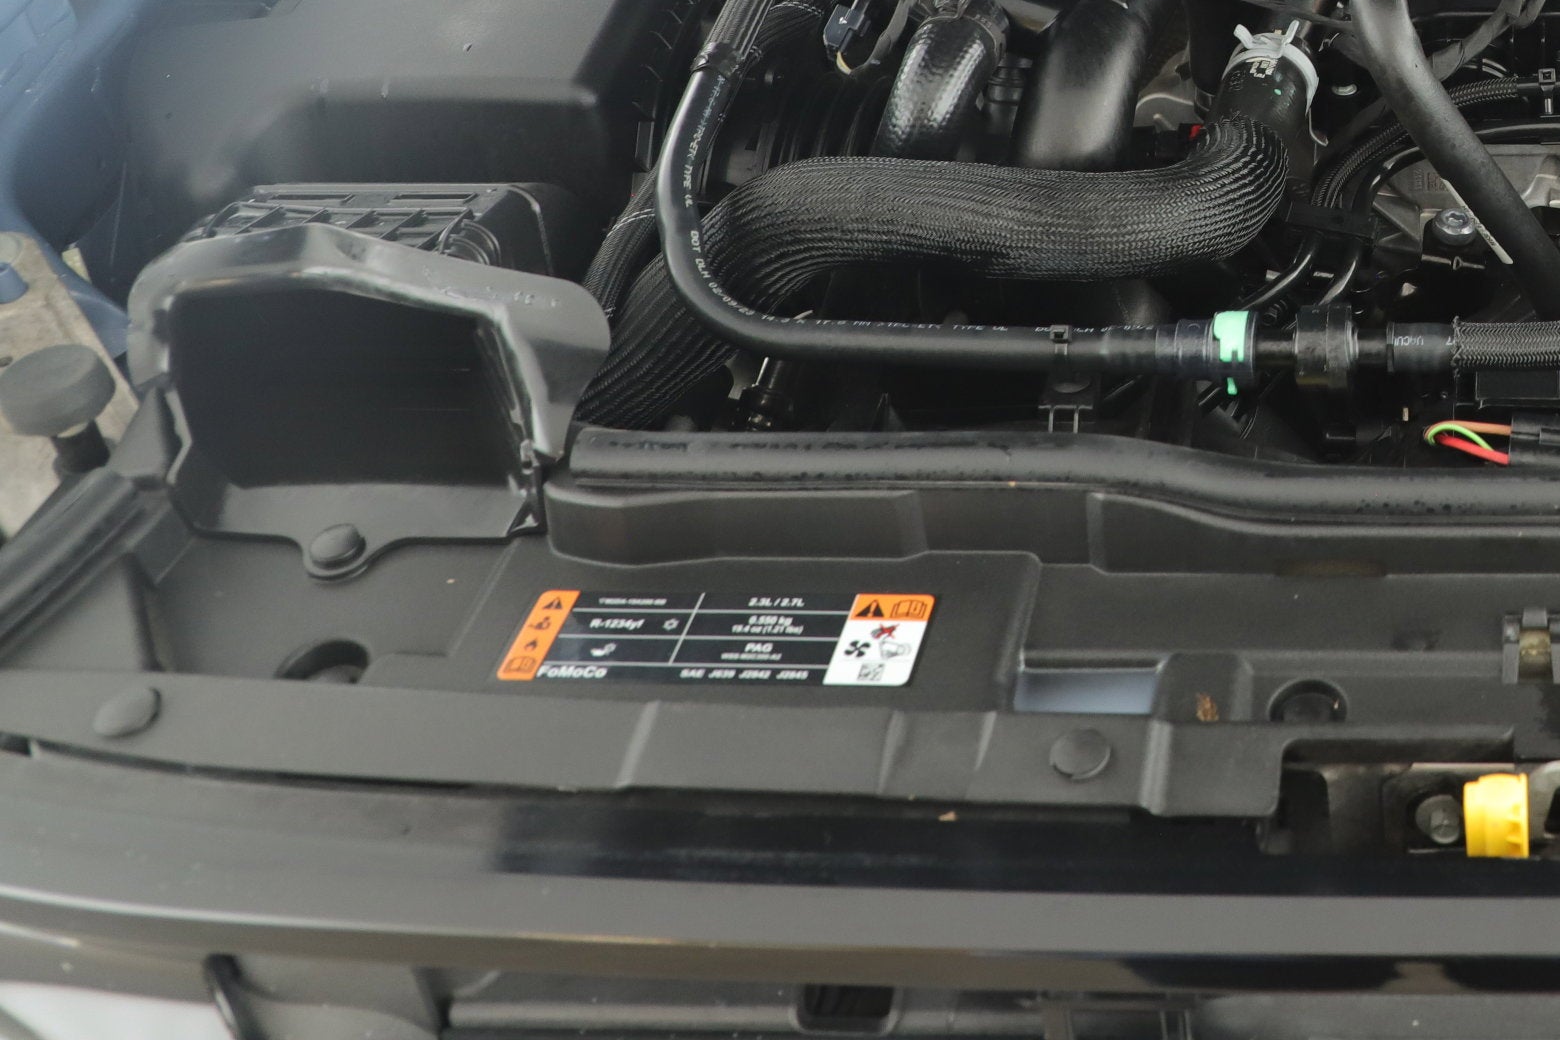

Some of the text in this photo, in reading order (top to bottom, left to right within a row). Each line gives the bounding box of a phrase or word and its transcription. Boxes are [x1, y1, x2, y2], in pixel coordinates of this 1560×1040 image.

[690, 230, 702, 253] DOT
[748, 597, 772, 607] 2.3L
[780, 597, 805, 607] 2.7L
[589, 618, 645, 631] R-1234yf
[778, 616, 793, 627] kg
[744, 642, 774, 653] PAG
[536, 664, 608, 678] FoMoCo
[679, 668, 706, 679] SAE
